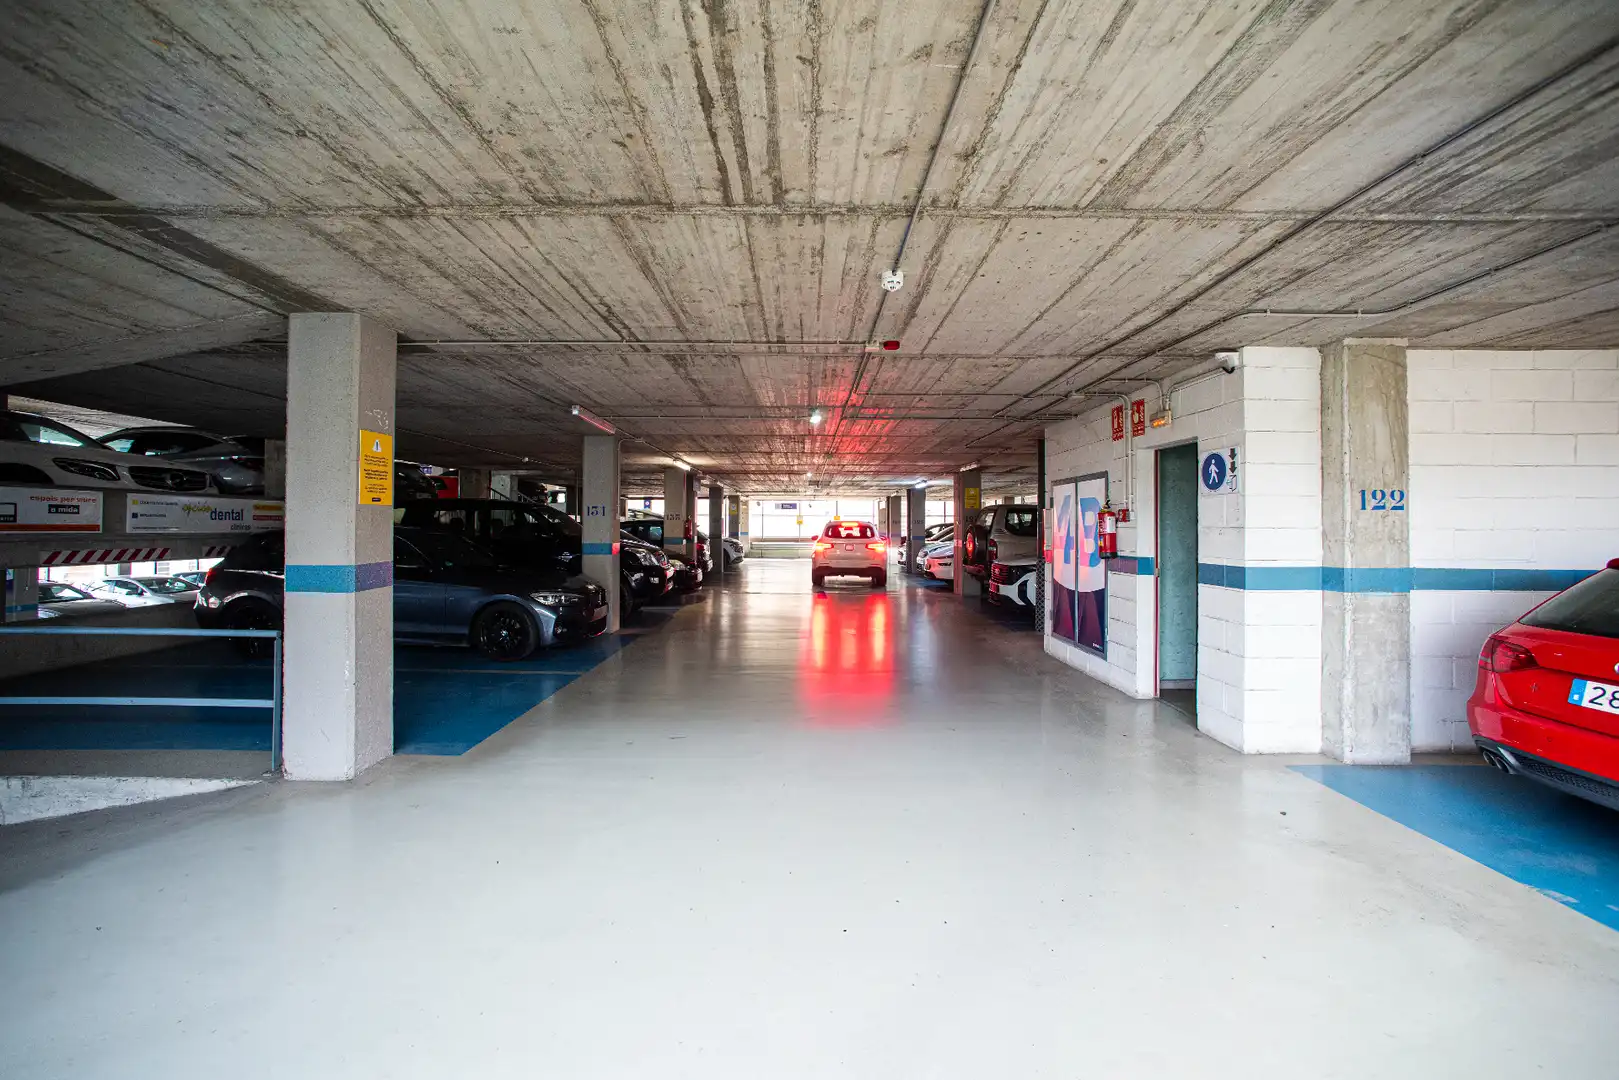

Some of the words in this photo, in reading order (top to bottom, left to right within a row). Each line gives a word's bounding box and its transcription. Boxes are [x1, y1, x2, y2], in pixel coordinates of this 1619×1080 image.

[1359, 489, 1405, 511] 122
[210, 508, 244, 521] dental
[1588, 686, 1619, 709] 28
